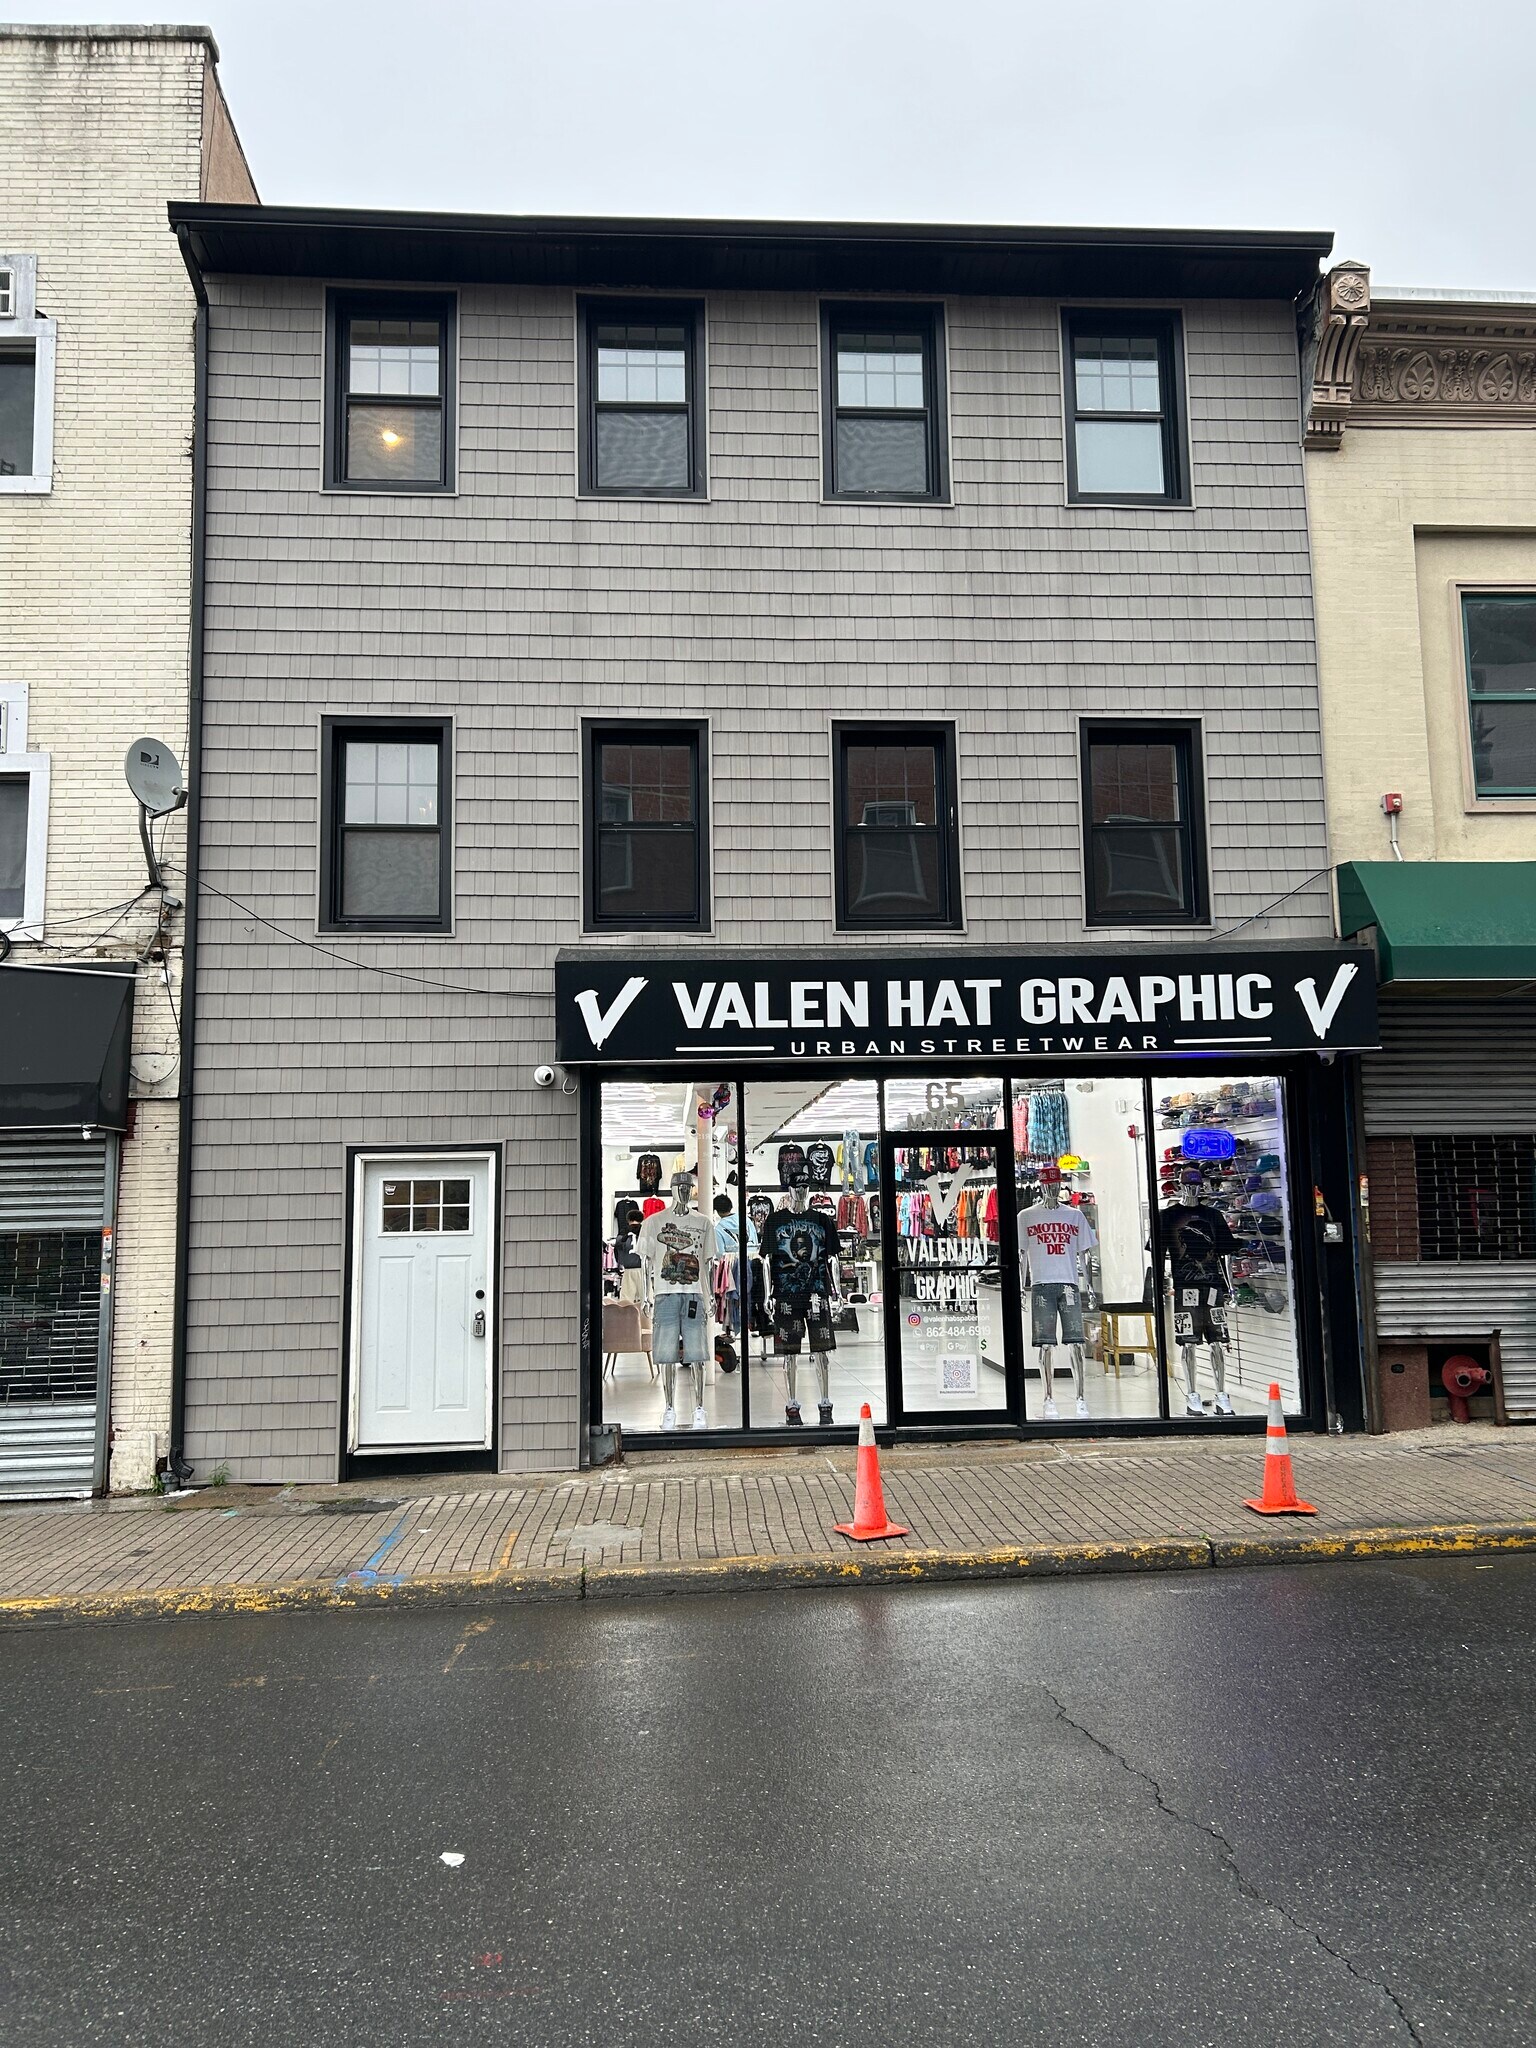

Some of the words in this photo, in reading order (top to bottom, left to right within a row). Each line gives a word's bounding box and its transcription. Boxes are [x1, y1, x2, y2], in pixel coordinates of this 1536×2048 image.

[671, 981, 869, 1029] VALEN
[887, 979, 1002, 1027] HAT
[1020, 973, 1274, 1025] GRAPHIC
[790, 1040, 906, 1055] URBAN
[920, 1035, 1158, 1053] STREETWEAR
[926, 1081, 965, 1112] 65
[1186, 1136, 1230, 1154] OPEN
[1026, 1222, 1079, 1237] EMOTIONS
[1037, 1233, 1071, 1245] NEVER
[906, 1237, 958, 1263] VALEN
[961, 1237, 989, 1262] HAT
[1047, 1244, 1066, 1255] DIE
[916, 1274, 980, 1300] GRAPHIC
[911, 1305, 937, 1313] URBAN
[939, 1304, 991, 1312] STREETWAR
[922, 1315, 990, 1324] @valenhatspateron
[926, 1325, 991, 1337] 862-484-6919
